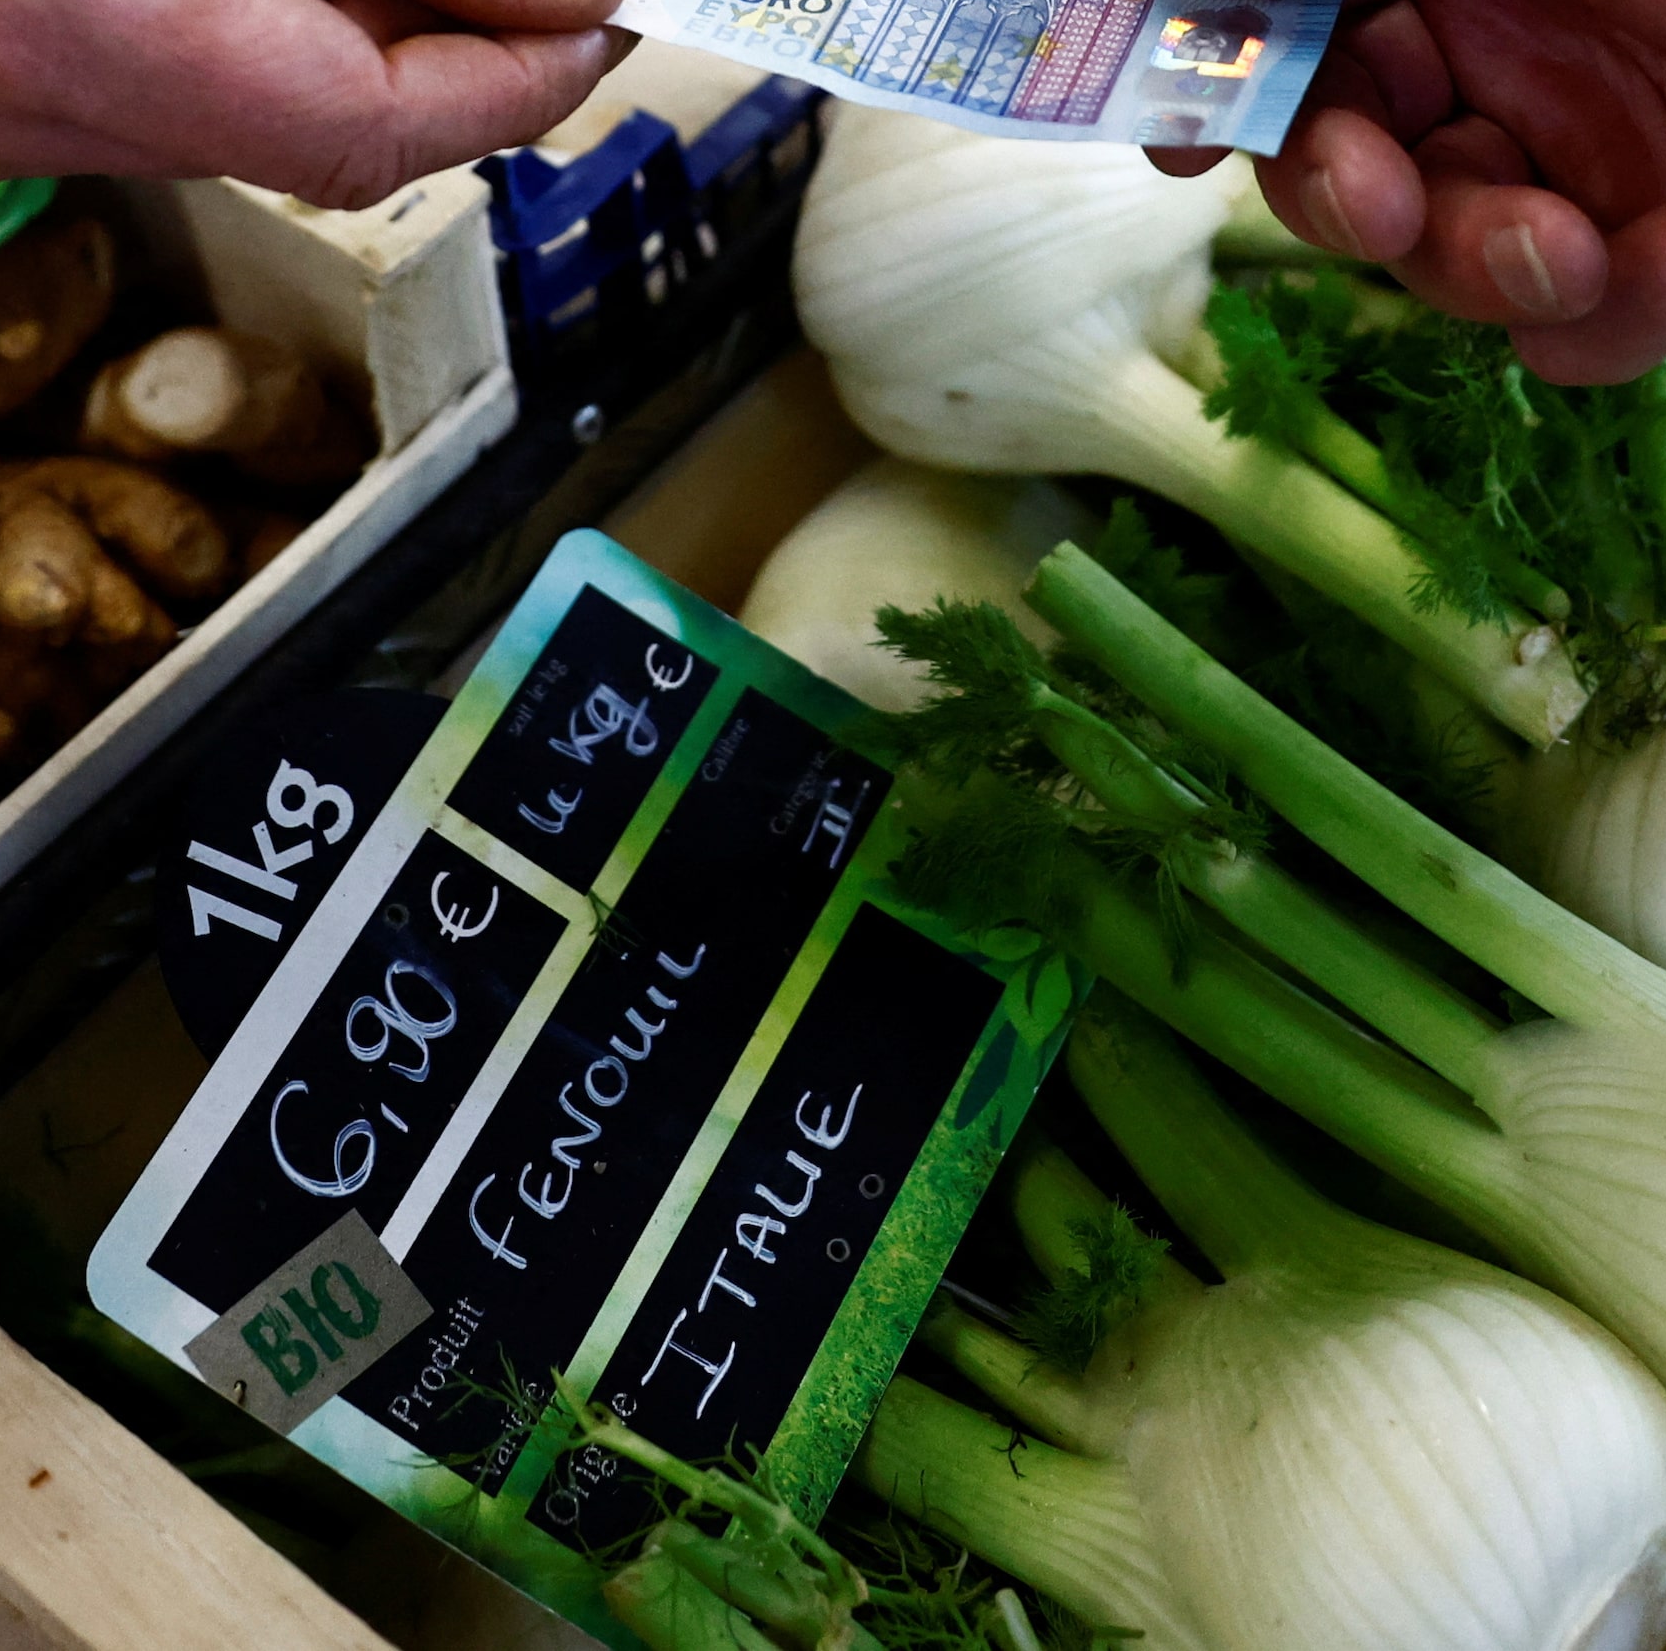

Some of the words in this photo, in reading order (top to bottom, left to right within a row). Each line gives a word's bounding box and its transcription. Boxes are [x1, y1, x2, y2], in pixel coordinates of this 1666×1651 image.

[645, 643, 693, 691] €
[701, 717, 751, 782] Calibre
[190, 759, 354, 943] 1kg
[429, 870, 499, 944] €
[238, 1258, 382, 1399] BIO
[388, 1297, 484, 1432] Produit
